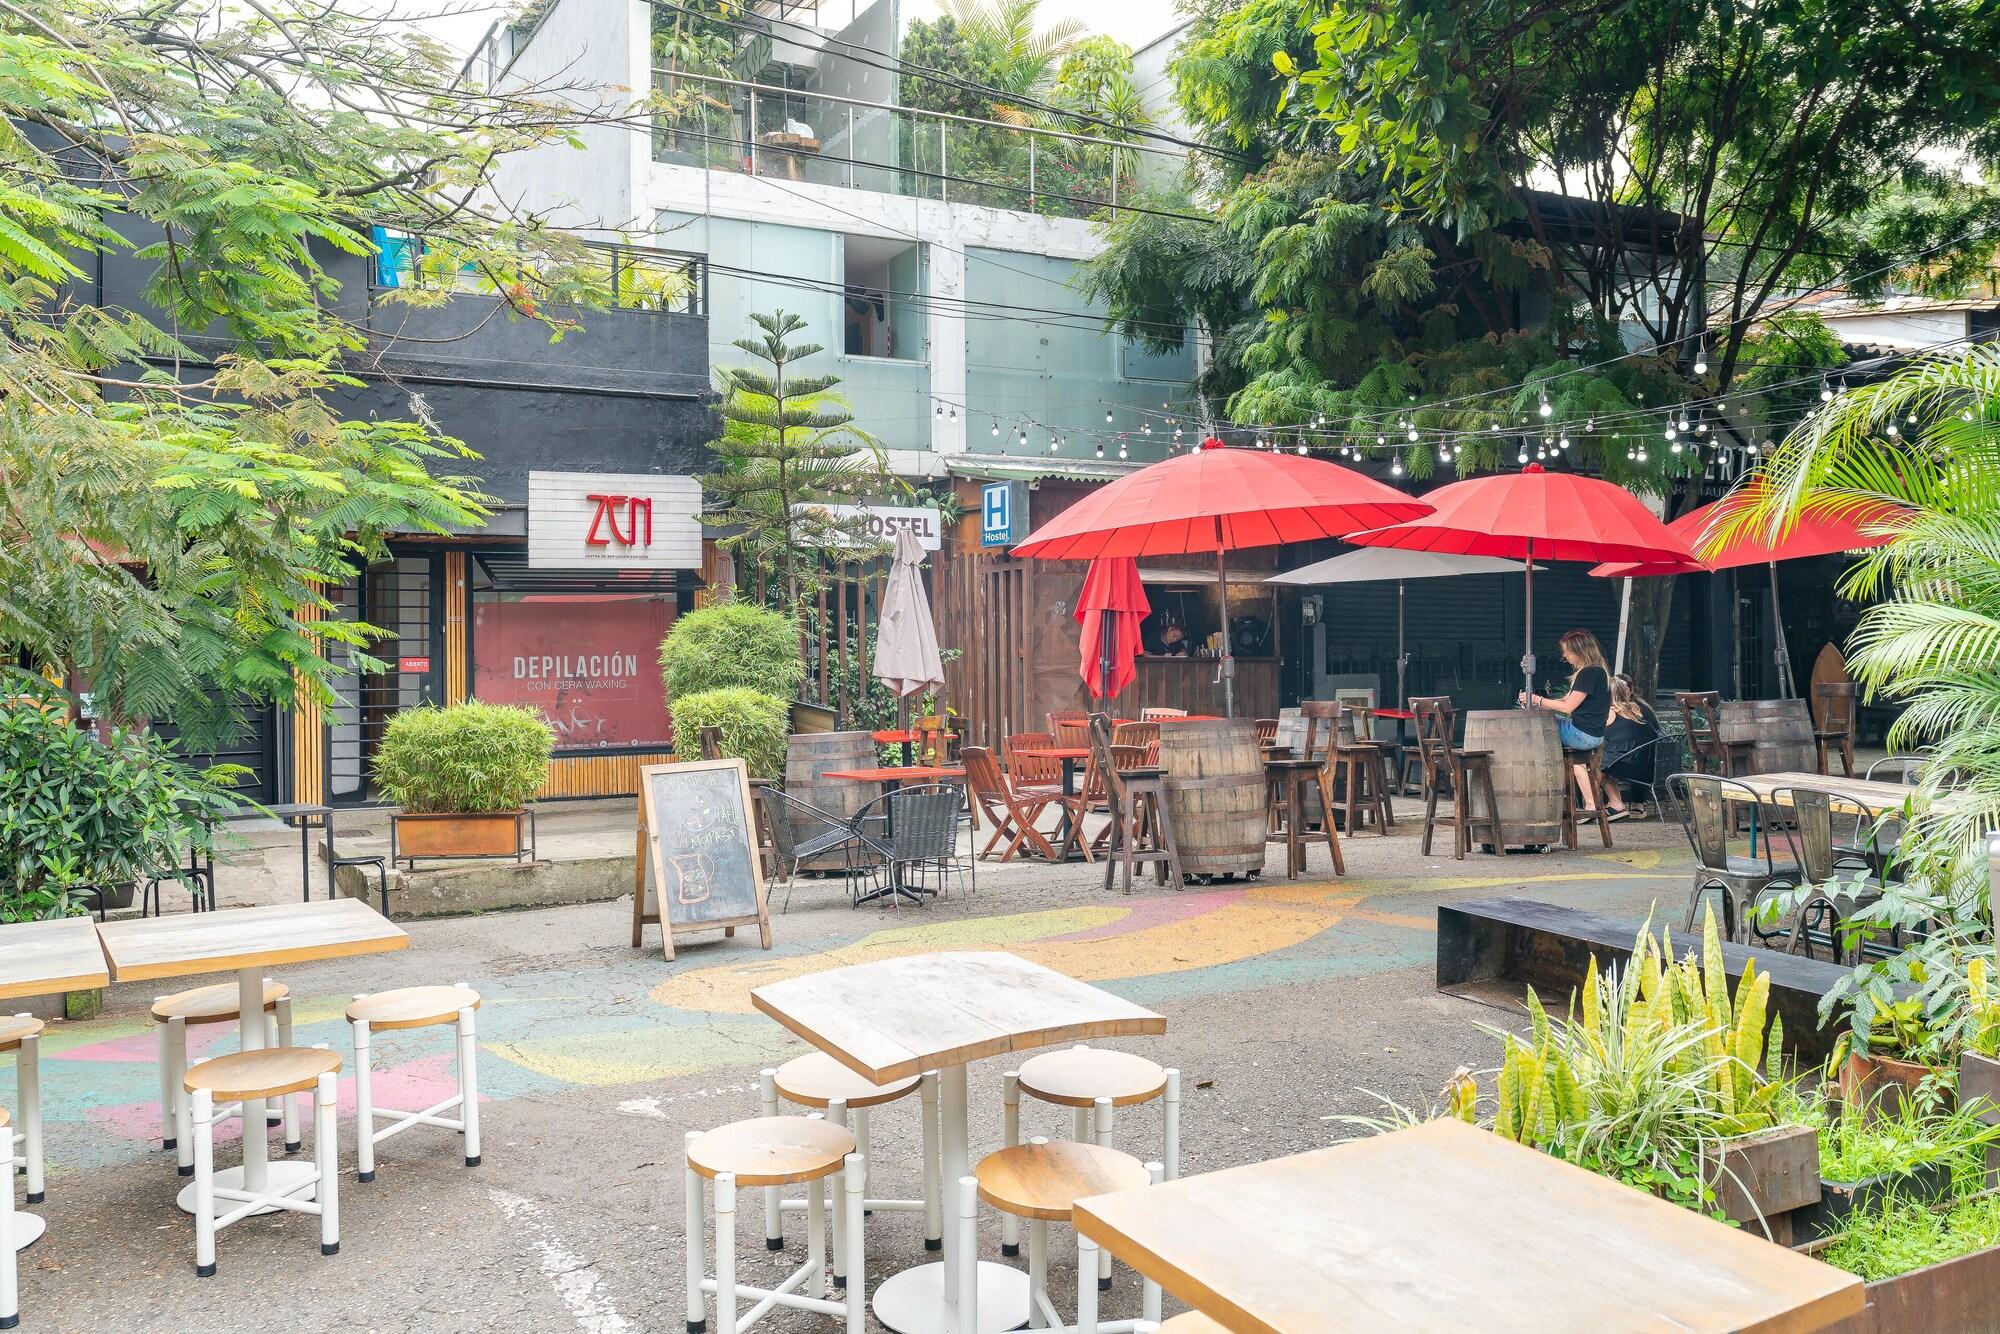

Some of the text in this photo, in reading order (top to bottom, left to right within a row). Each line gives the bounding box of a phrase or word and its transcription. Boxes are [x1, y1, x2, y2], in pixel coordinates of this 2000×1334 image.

[585, 495, 652, 545] ZEN
[987, 489, 1006, 528] H
[858, 516, 934, 538] OSTEL
[985, 530, 1009, 542] Hostel
[513, 650, 637, 679] DEPILACIÓN
[527, 679, 627, 691] CON CERA WAXING
